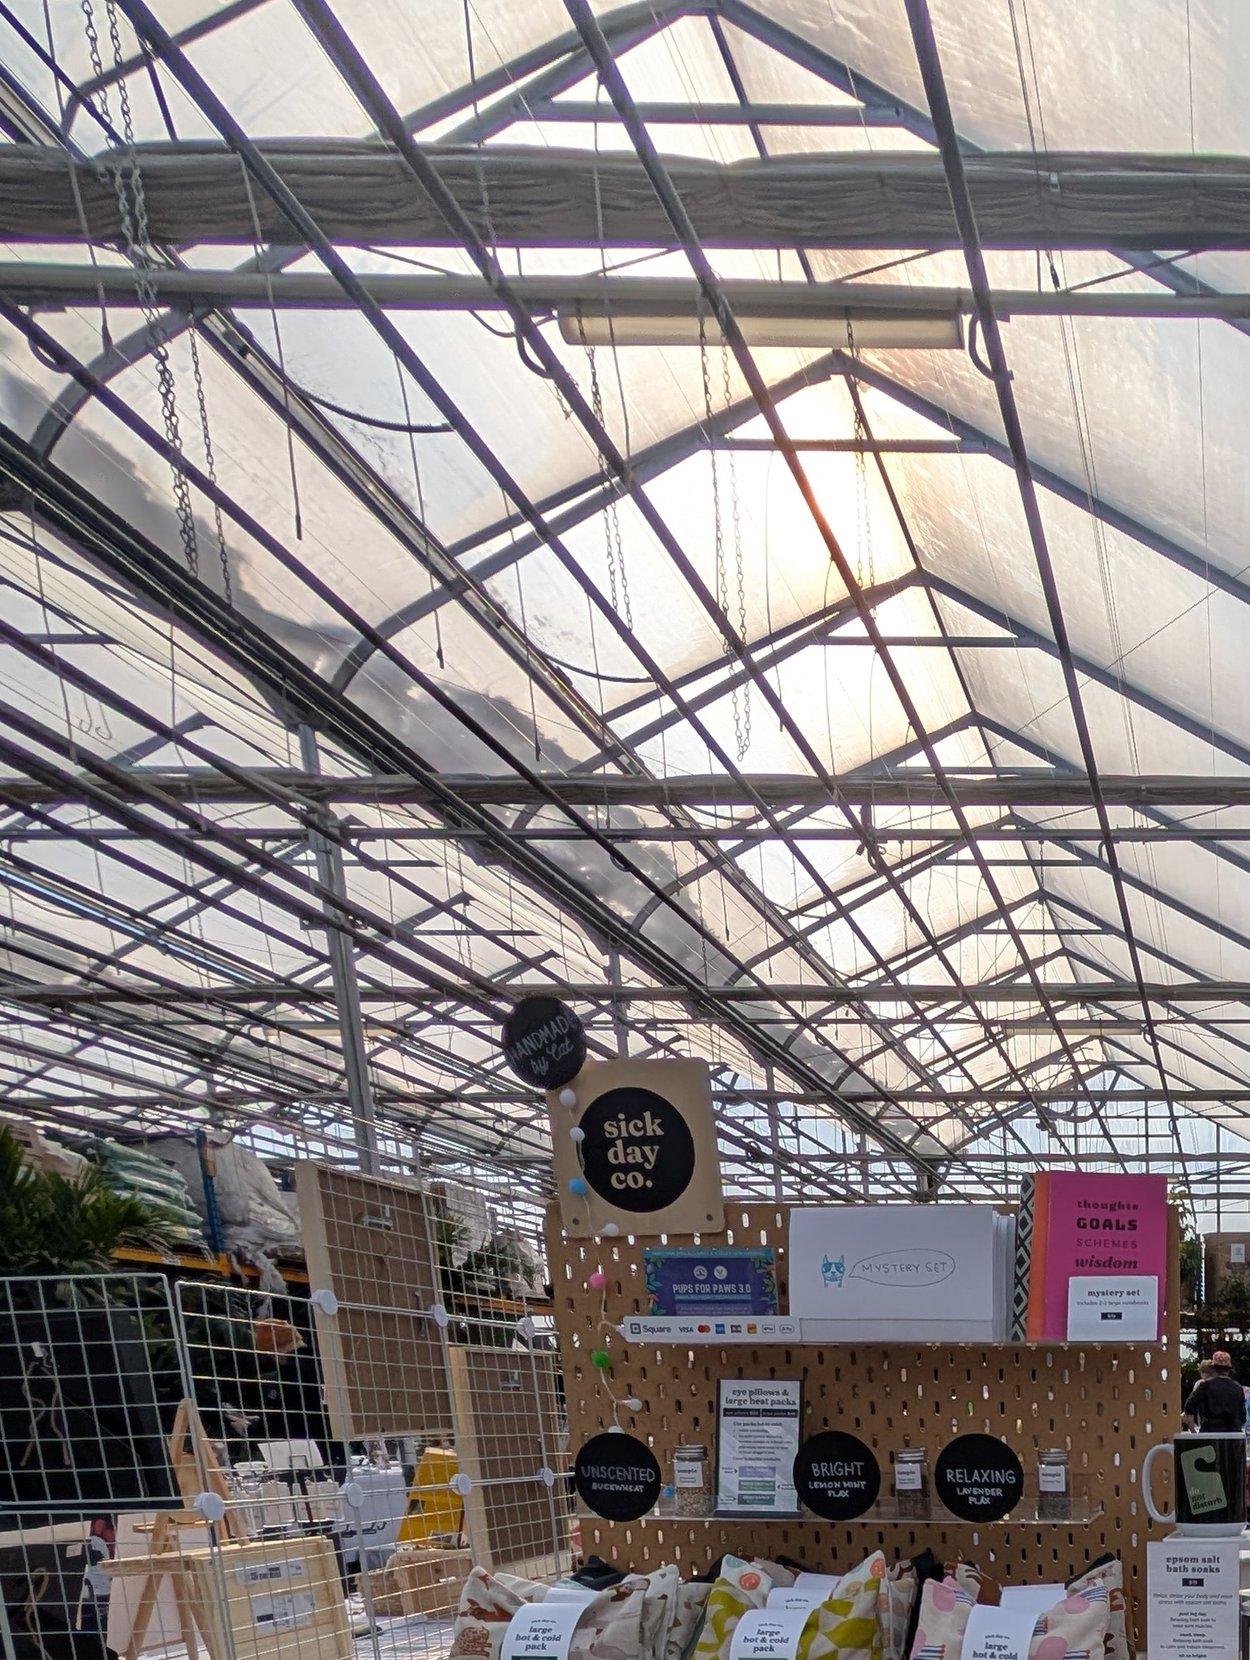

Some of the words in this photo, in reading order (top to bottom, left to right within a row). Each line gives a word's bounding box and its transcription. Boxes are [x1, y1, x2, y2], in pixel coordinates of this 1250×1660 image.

[530, 1056, 549, 1075] by
[603, 1111, 665, 1138] sick
[607, 1139, 660, 1169] day
[610, 1171, 653, 1189] co.
[1077, 1200, 1139, 1212] thoughts
[1076, 1217, 1138, 1231] GOALS
[1076, 1238, 1138, 1249] SCHEMES
[1074, 1255, 1138, 1270] wisdom
[862, 1262, 920, 1274] MYSTERY
[926, 1262, 948, 1274] SET
[672, 1284, 694, 1294] PUPS
[694, 1284, 711, 1294] FOR
[712, 1284, 737, 1294] PAWS
[738, 1284, 752, 1294] 3.0
[1087, 1289, 1125, 1298] mystery
[1126, 1289, 1140, 1297] set
[643, 1325, 672, 1333] Square
[580, 1464, 656, 1483] UNSCENTED
[811, 1461, 865, 1477] BRIGHT
[946, 1468, 1017, 1484] RELAXING
[591, 1482, 644, 1493] BUCKWHEAT
[808, 1481, 841, 1489] LEMON
[842, 1481, 867, 1489] MINT
[956, 1487, 1003, 1497] LAVENDER
[1189, 1486, 1200, 1495] do
[1192, 1497, 1223, 1511] disturb
[1166, 1555, 1199, 1564] epsom
[1201, 1555, 1221, 1563] salt
[1166, 1565, 1189, 1573] bath
[1191, 1565, 1220, 1573] soaks
[529, 1626, 553, 1634] large
[757, 1629, 781, 1637] large
[525, 1643, 547, 1651] pack
[753, 1645, 775, 1653] pack
[984, 1642, 1008, 1651] large
[972, 1651, 988, 1659] hot
[998, 1652, 1018, 1660] cold
